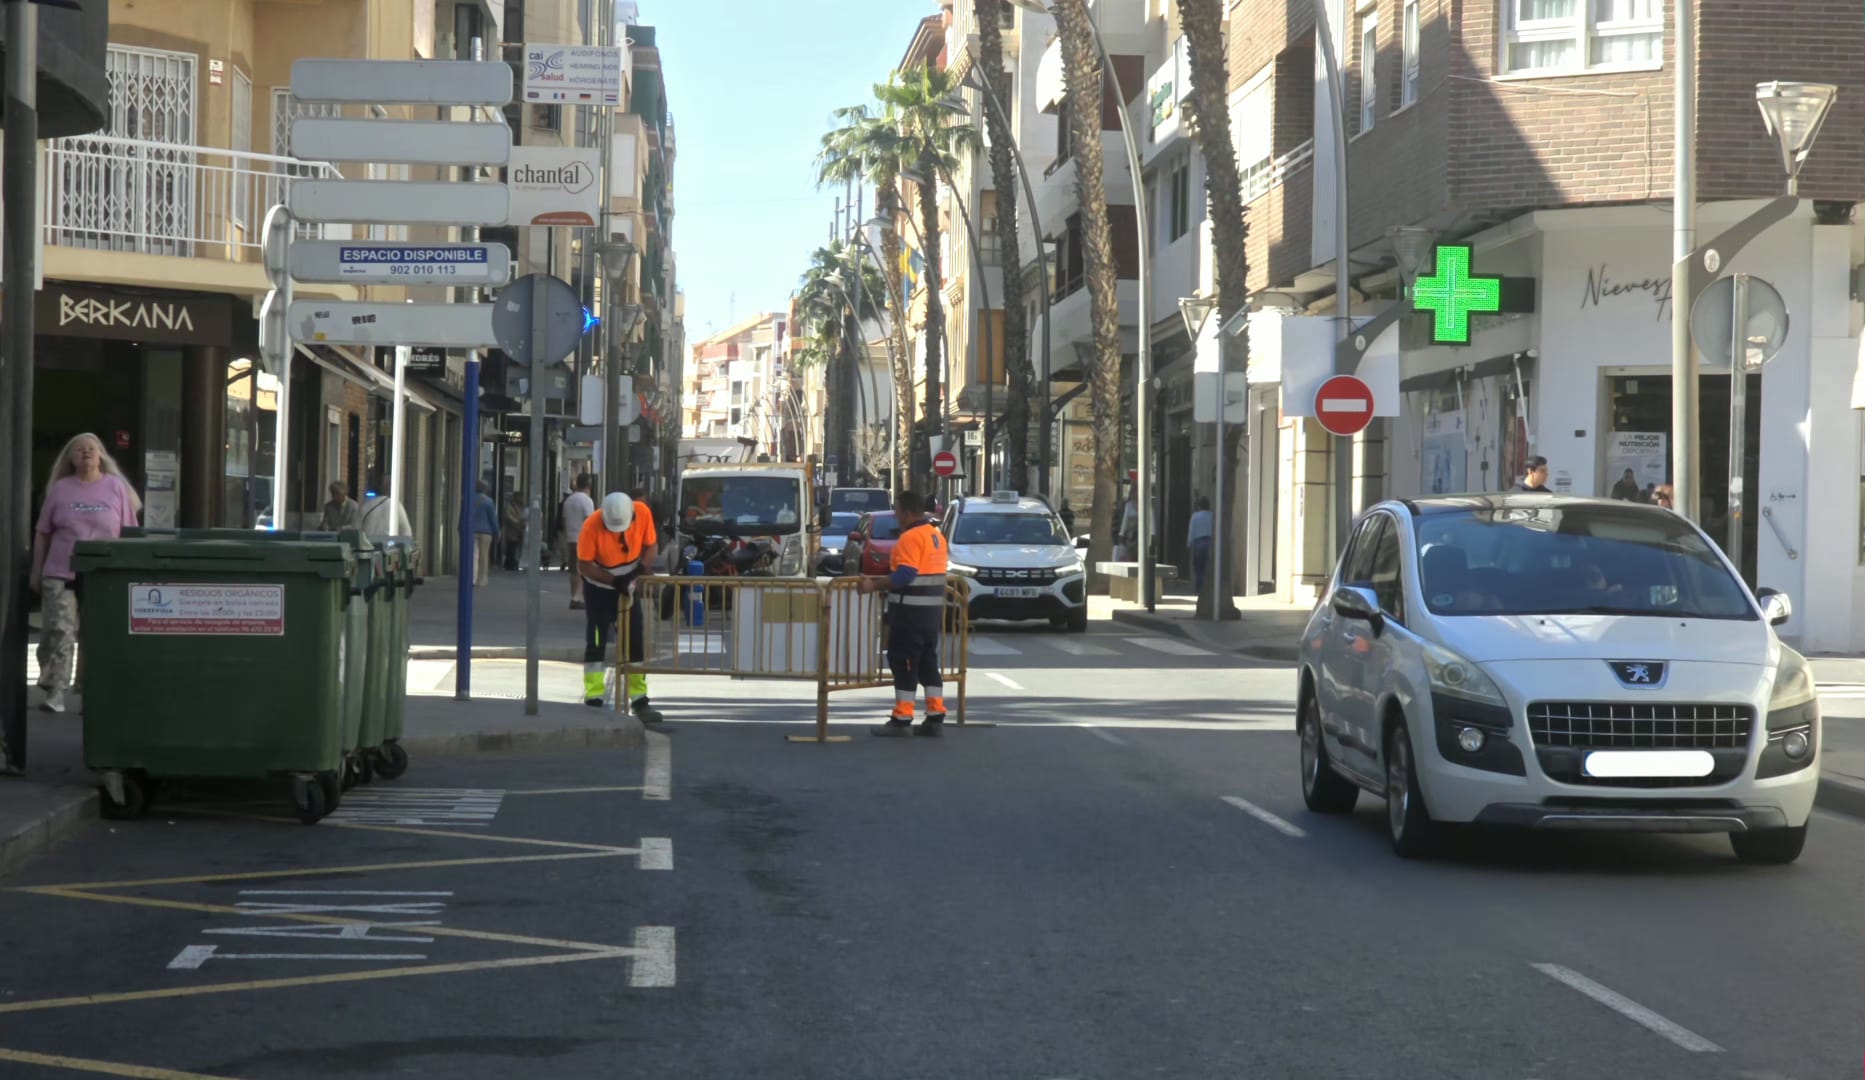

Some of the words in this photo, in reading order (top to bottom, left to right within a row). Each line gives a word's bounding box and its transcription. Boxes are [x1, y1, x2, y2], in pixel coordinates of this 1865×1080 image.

[528, 50, 543, 60] cai
[541, 73, 564, 81] salud
[514, 163, 579, 184] chantal
[343, 249, 401, 261] ESPACIO
[404, 250, 483, 261] DISPONIBLE
[390, 264, 410, 275] 902
[413, 265, 434, 275] 010
[438, 265, 456, 275] 113
[1580, 263, 1670, 310] Nieves
[59, 293, 194, 331] BERKANA
[179, 589, 223, 597] RESIDUOS
[224, 589, 279, 598] ORGÁNICOS
[166, 889, 454, 969] TAXI
